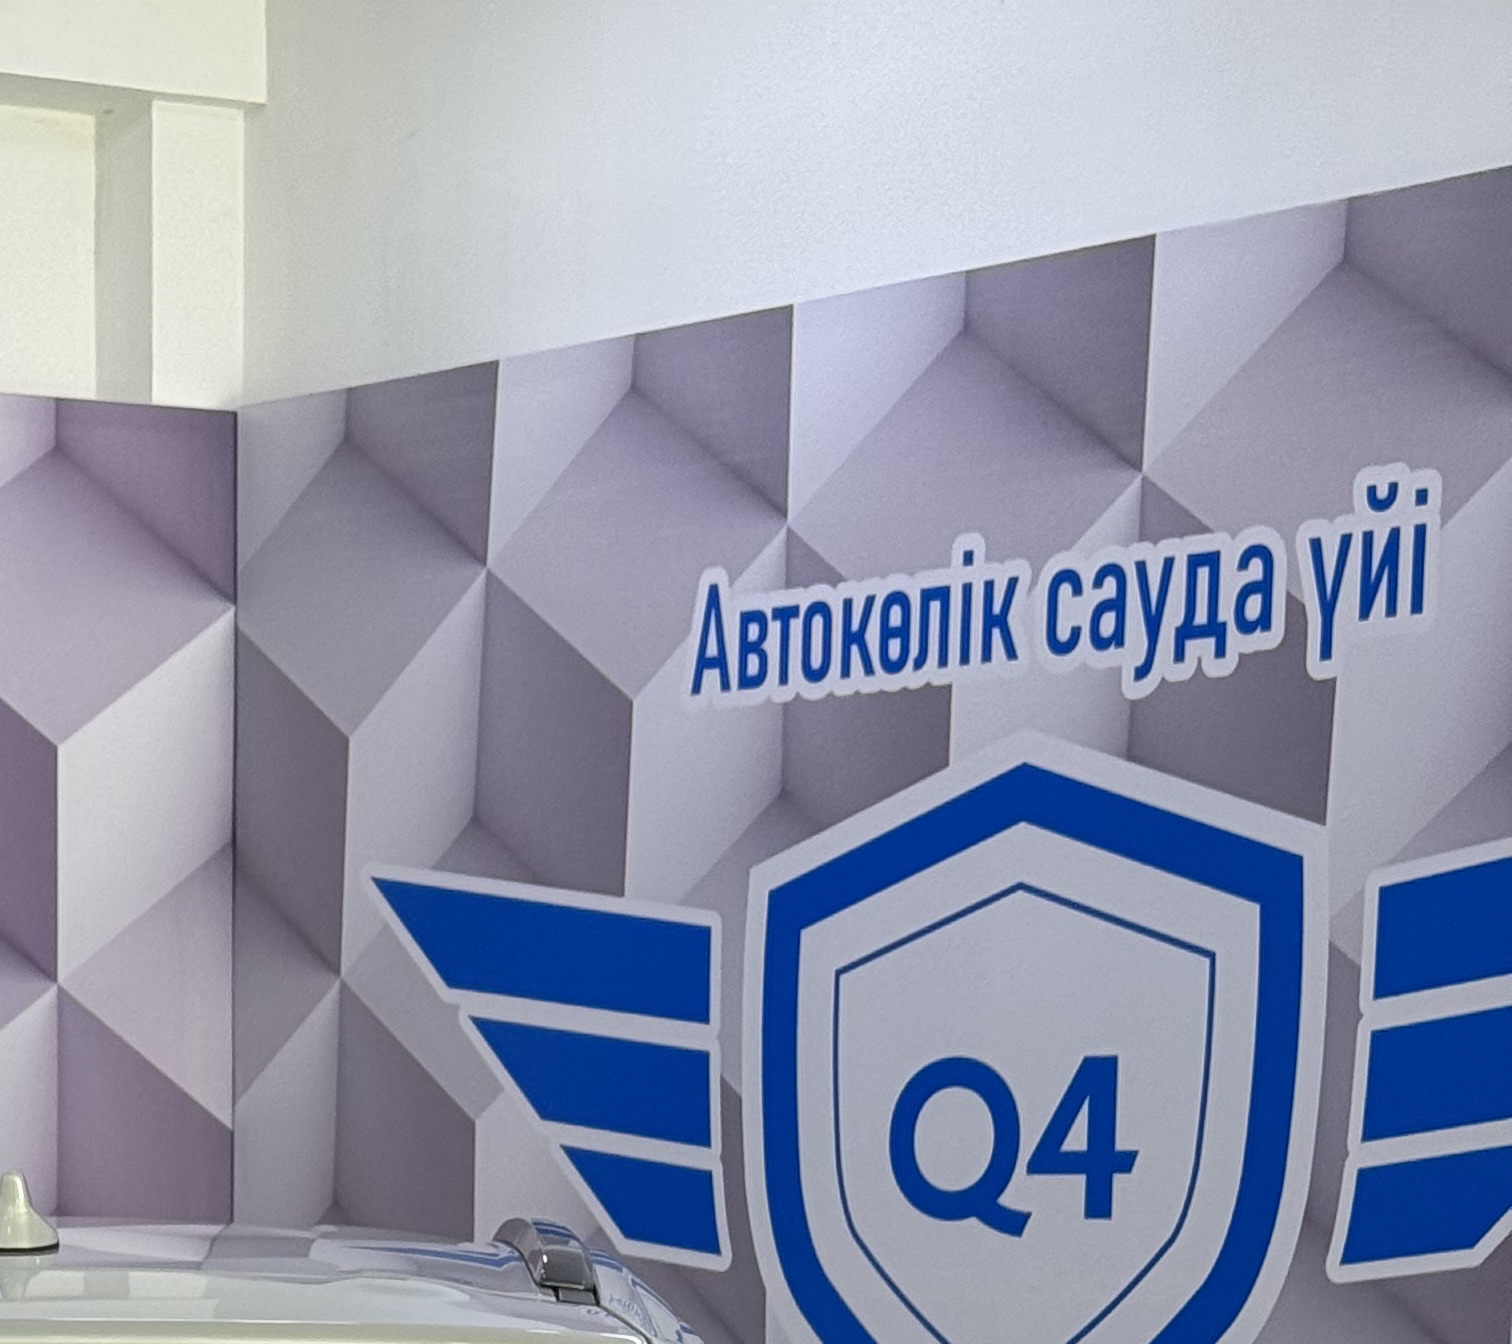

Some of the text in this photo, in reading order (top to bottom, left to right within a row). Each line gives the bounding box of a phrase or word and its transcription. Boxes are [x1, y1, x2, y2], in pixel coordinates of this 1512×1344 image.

[690, 481, 1430, 697] Автокөлік сауда үйі
[887, 1054, 1140, 1239] Q4
